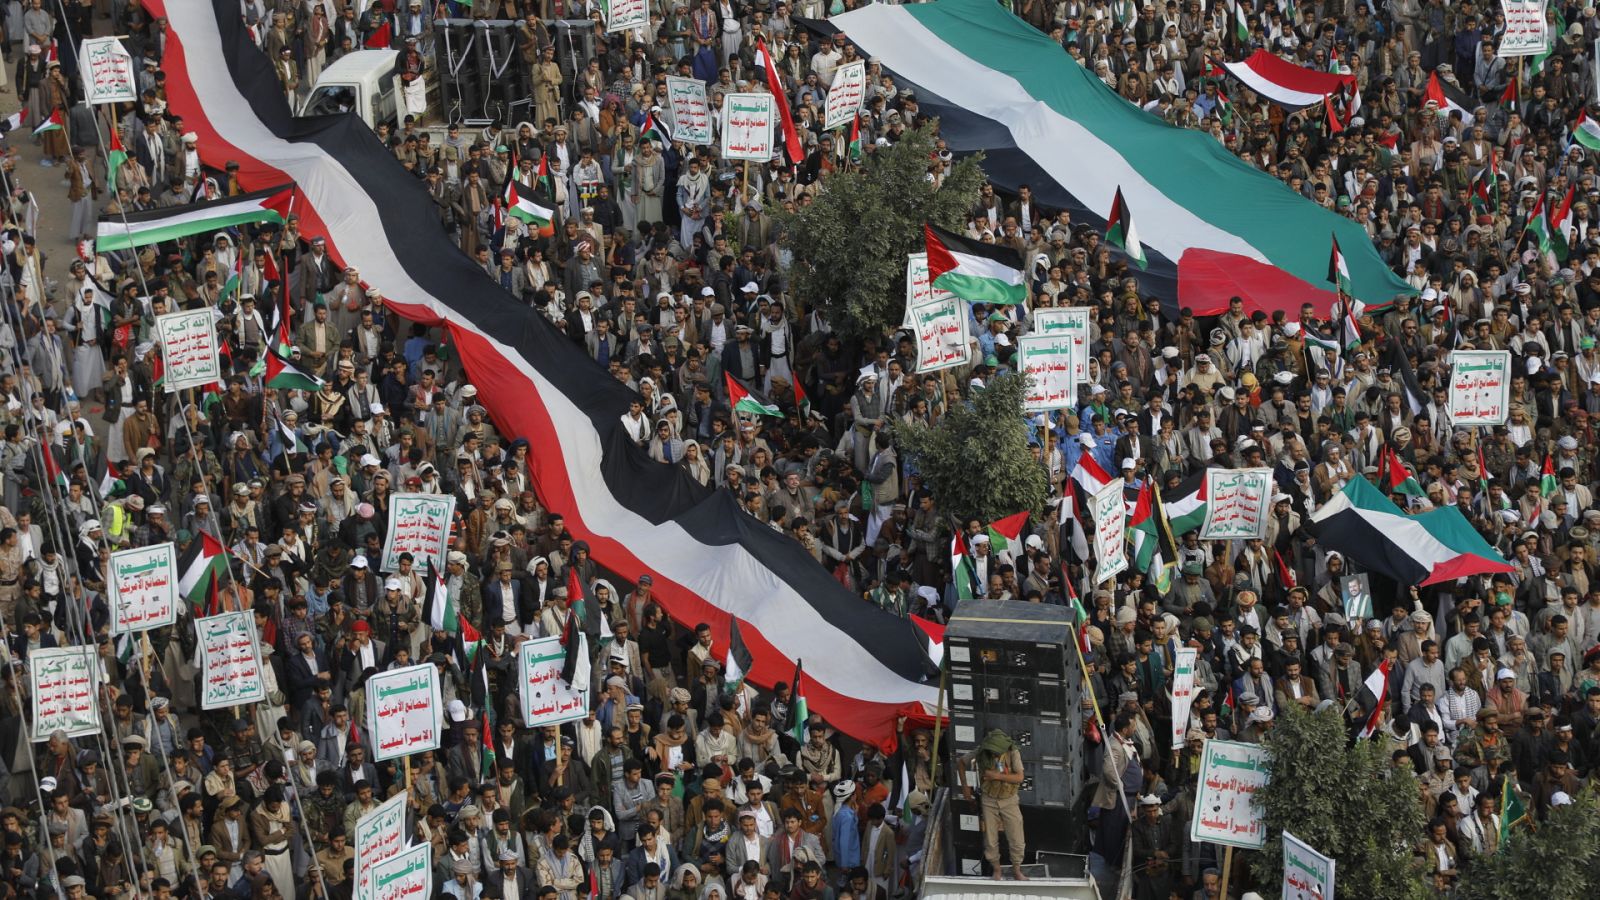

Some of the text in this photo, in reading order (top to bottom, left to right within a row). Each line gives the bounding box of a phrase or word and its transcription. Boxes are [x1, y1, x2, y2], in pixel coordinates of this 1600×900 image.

[193, 316, 209, 327] الله
[1244, 475, 1263, 488] الله
[427, 504, 446, 517] الله
[117, 554, 167, 578] قاطعوا
[237, 681, 259, 697] النصر
[376, 674, 428, 700] قاطعوا
[405, 697, 430, 713] البضائع
[70, 714, 92, 729] النصر
